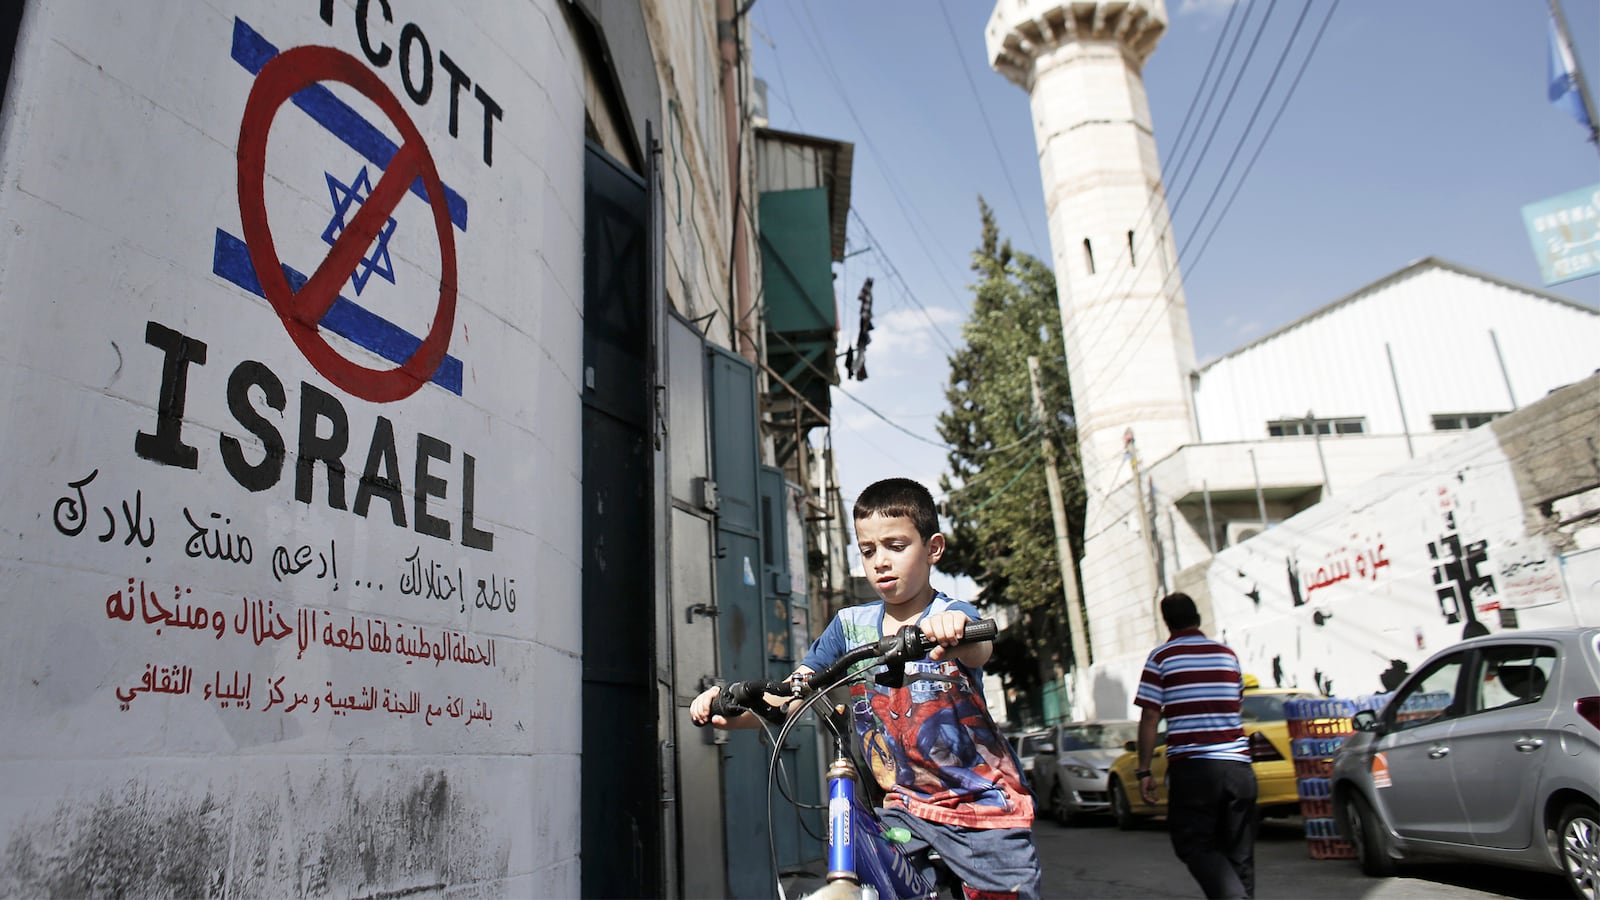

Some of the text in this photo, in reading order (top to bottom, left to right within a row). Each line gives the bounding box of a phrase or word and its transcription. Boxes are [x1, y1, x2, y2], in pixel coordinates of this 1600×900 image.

[135, 321, 494, 552] ISRAEL
[53, 469, 155, 564] بلادك
[183, 507, 253, 564] منتج
[106, 577, 226, 640] ومنتجاته
[475, 572, 516, 613] قاطع
[395, 623, 450, 668] الوطنية
[453, 631, 496, 667] الحملة
[116, 663, 193, 711] الثقافي
[324, 681, 377, 716] الشعبية
[382, 688, 420, 719] اللجنة
[425, 704, 442, 726] مع
